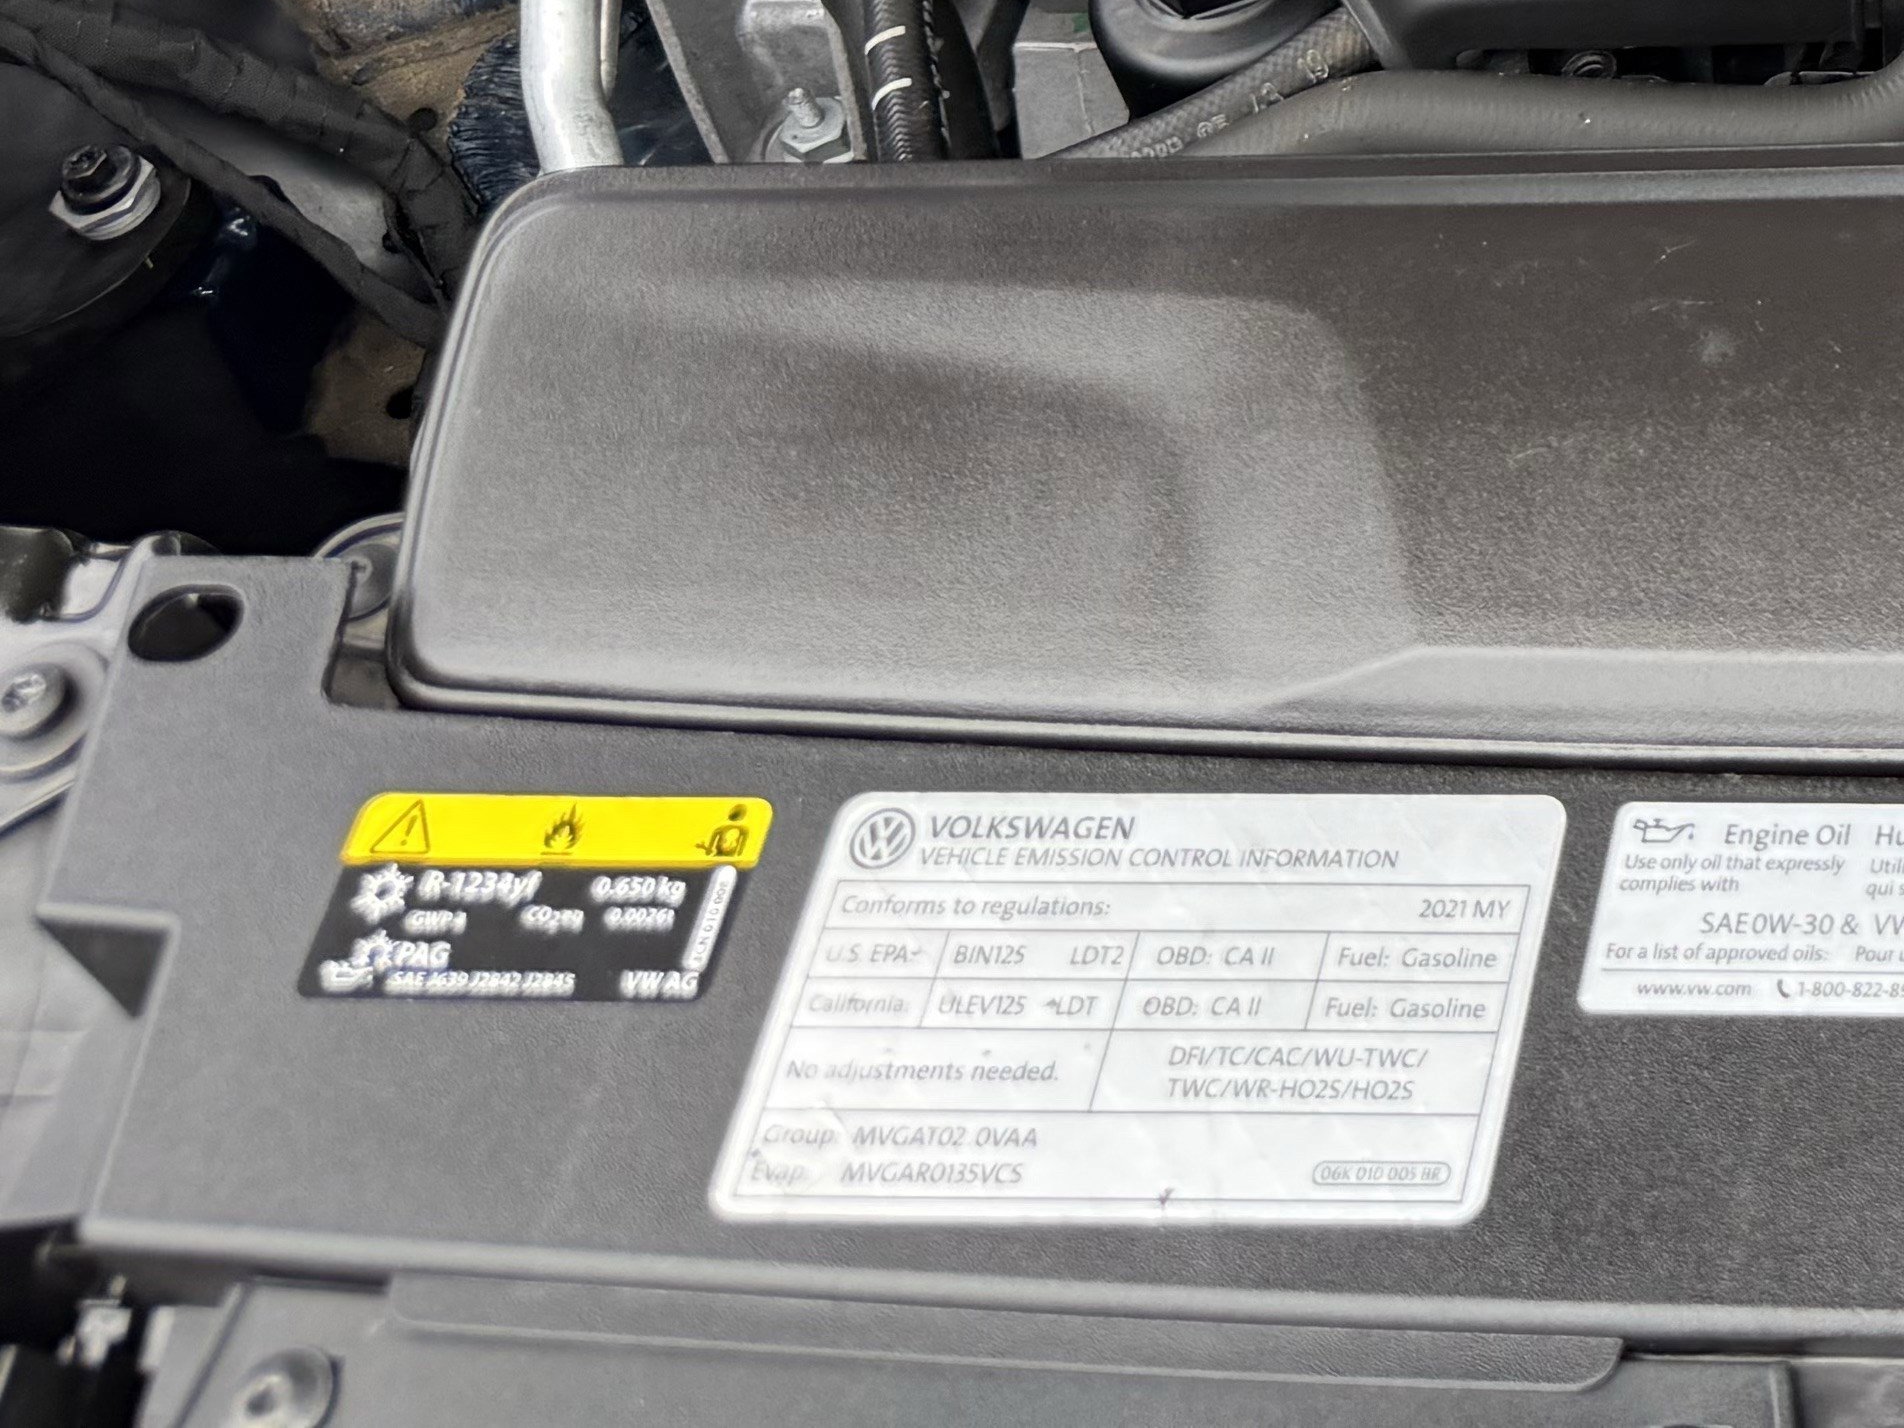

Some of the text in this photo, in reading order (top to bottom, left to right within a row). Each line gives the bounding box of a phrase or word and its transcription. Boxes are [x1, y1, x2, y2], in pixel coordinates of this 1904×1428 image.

[931, 816, 1135, 840] VOLKSWAGEN
[1724, 824, 1852, 851] Engine Oil
[921, 847, 1399, 870] VEHICLE EMISSION CONTROL INFORMATION
[1625, 854, 1846, 876] Use only that expressly
[417, 869, 687, 907] R-1234yf 0.650 kg
[1618, 877, 1740, 895] complies with
[1865, 882, 1894, 899] qui
[841, 895, 1511, 920] Conforms regulations: 2021 MY
[394, 940, 452, 969] PAG
[954, 945, 1498, 969] BIN125 LDT2 Fuel: Gasoline
[1705, 944, 1787, 964] approved
[1855, 946, 1894, 963] Pour
[621, 970, 664, 998] VW
[663, 970, 699, 999] AG
[1637, 982, 1752, 996] www.vw.com
[938, 995, 1487, 1019] ULEV125 Fuel: Gasoline
[1168, 1046, 1430, 1068] DFI/TC/CAC/WU-TWC/
[824, 1060, 1059, 1085] adjustments needed.
[841, 1162, 1024, 1184] MVGAR0135VCS
